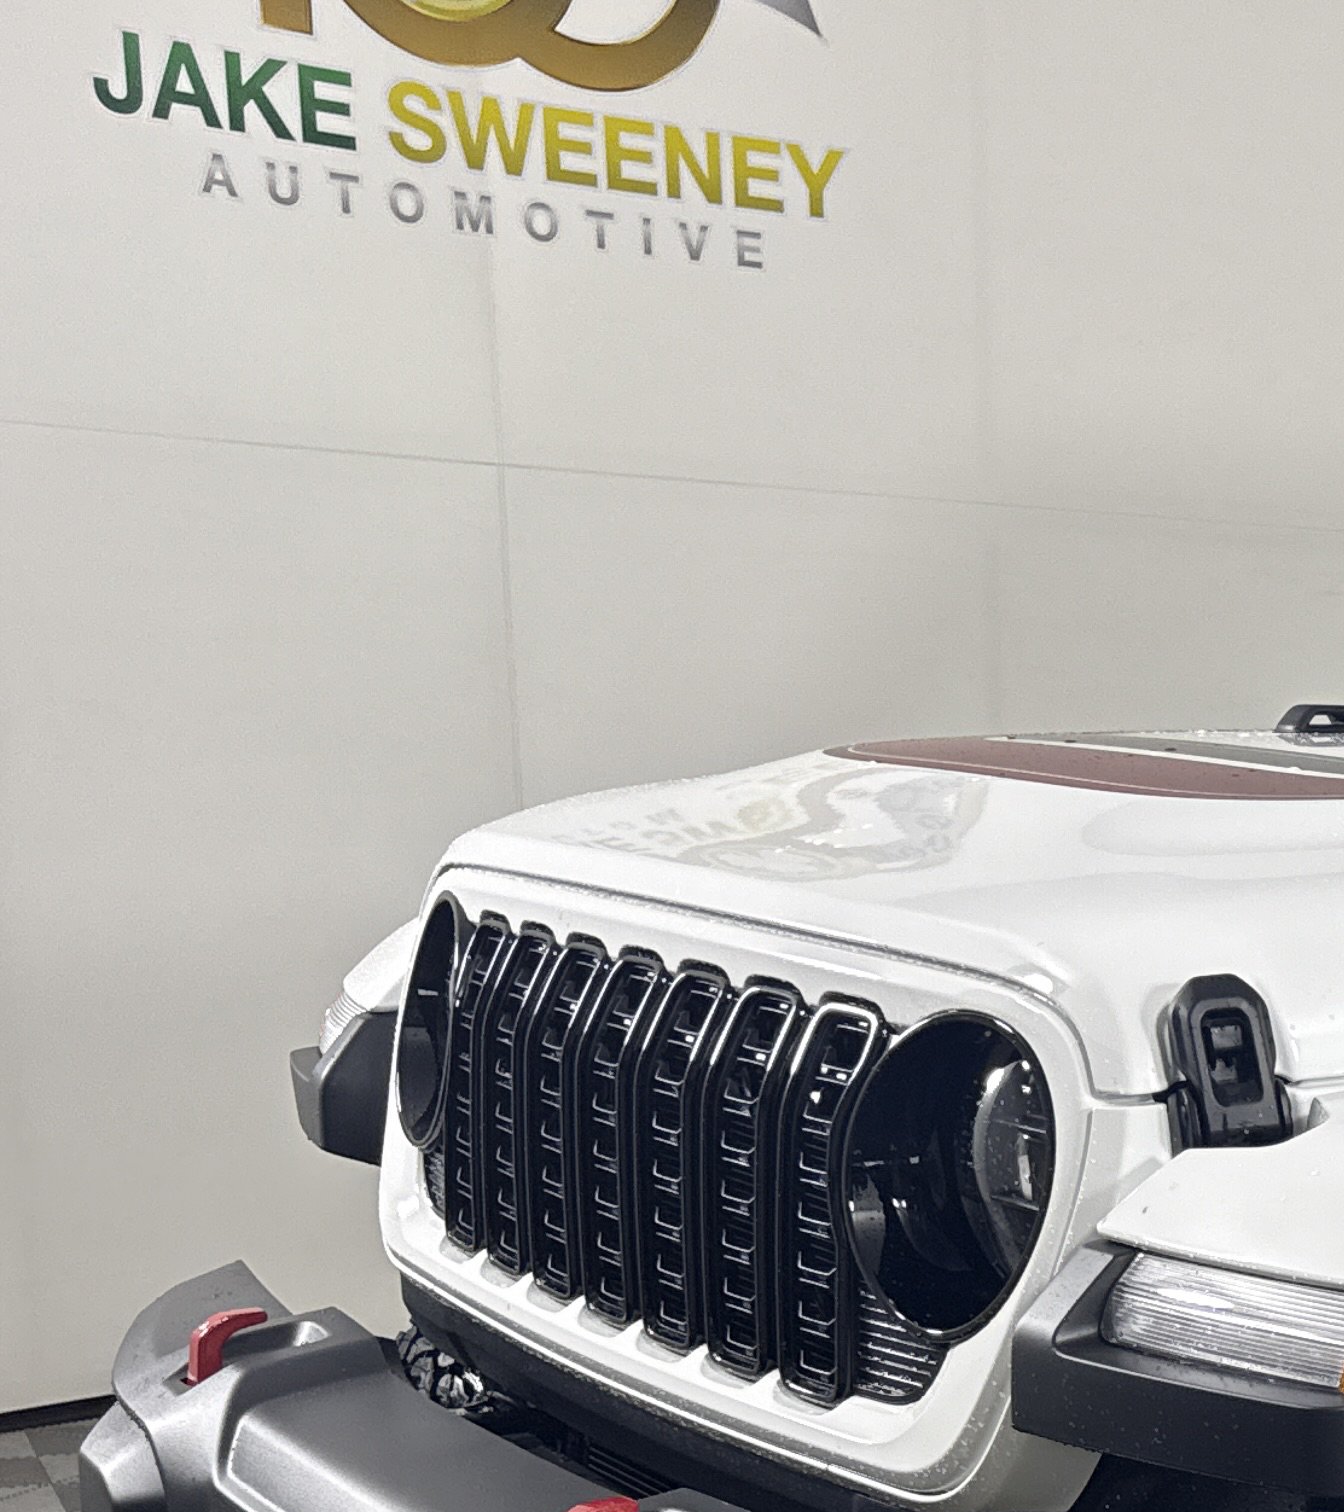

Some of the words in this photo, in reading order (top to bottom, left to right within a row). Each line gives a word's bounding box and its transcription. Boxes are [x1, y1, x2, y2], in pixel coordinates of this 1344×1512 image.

[93, 31, 357, 151] JAKE
[388, 81, 843, 218] SWEENEY
[202, 153, 764, 269] AUTOMOTIVE
